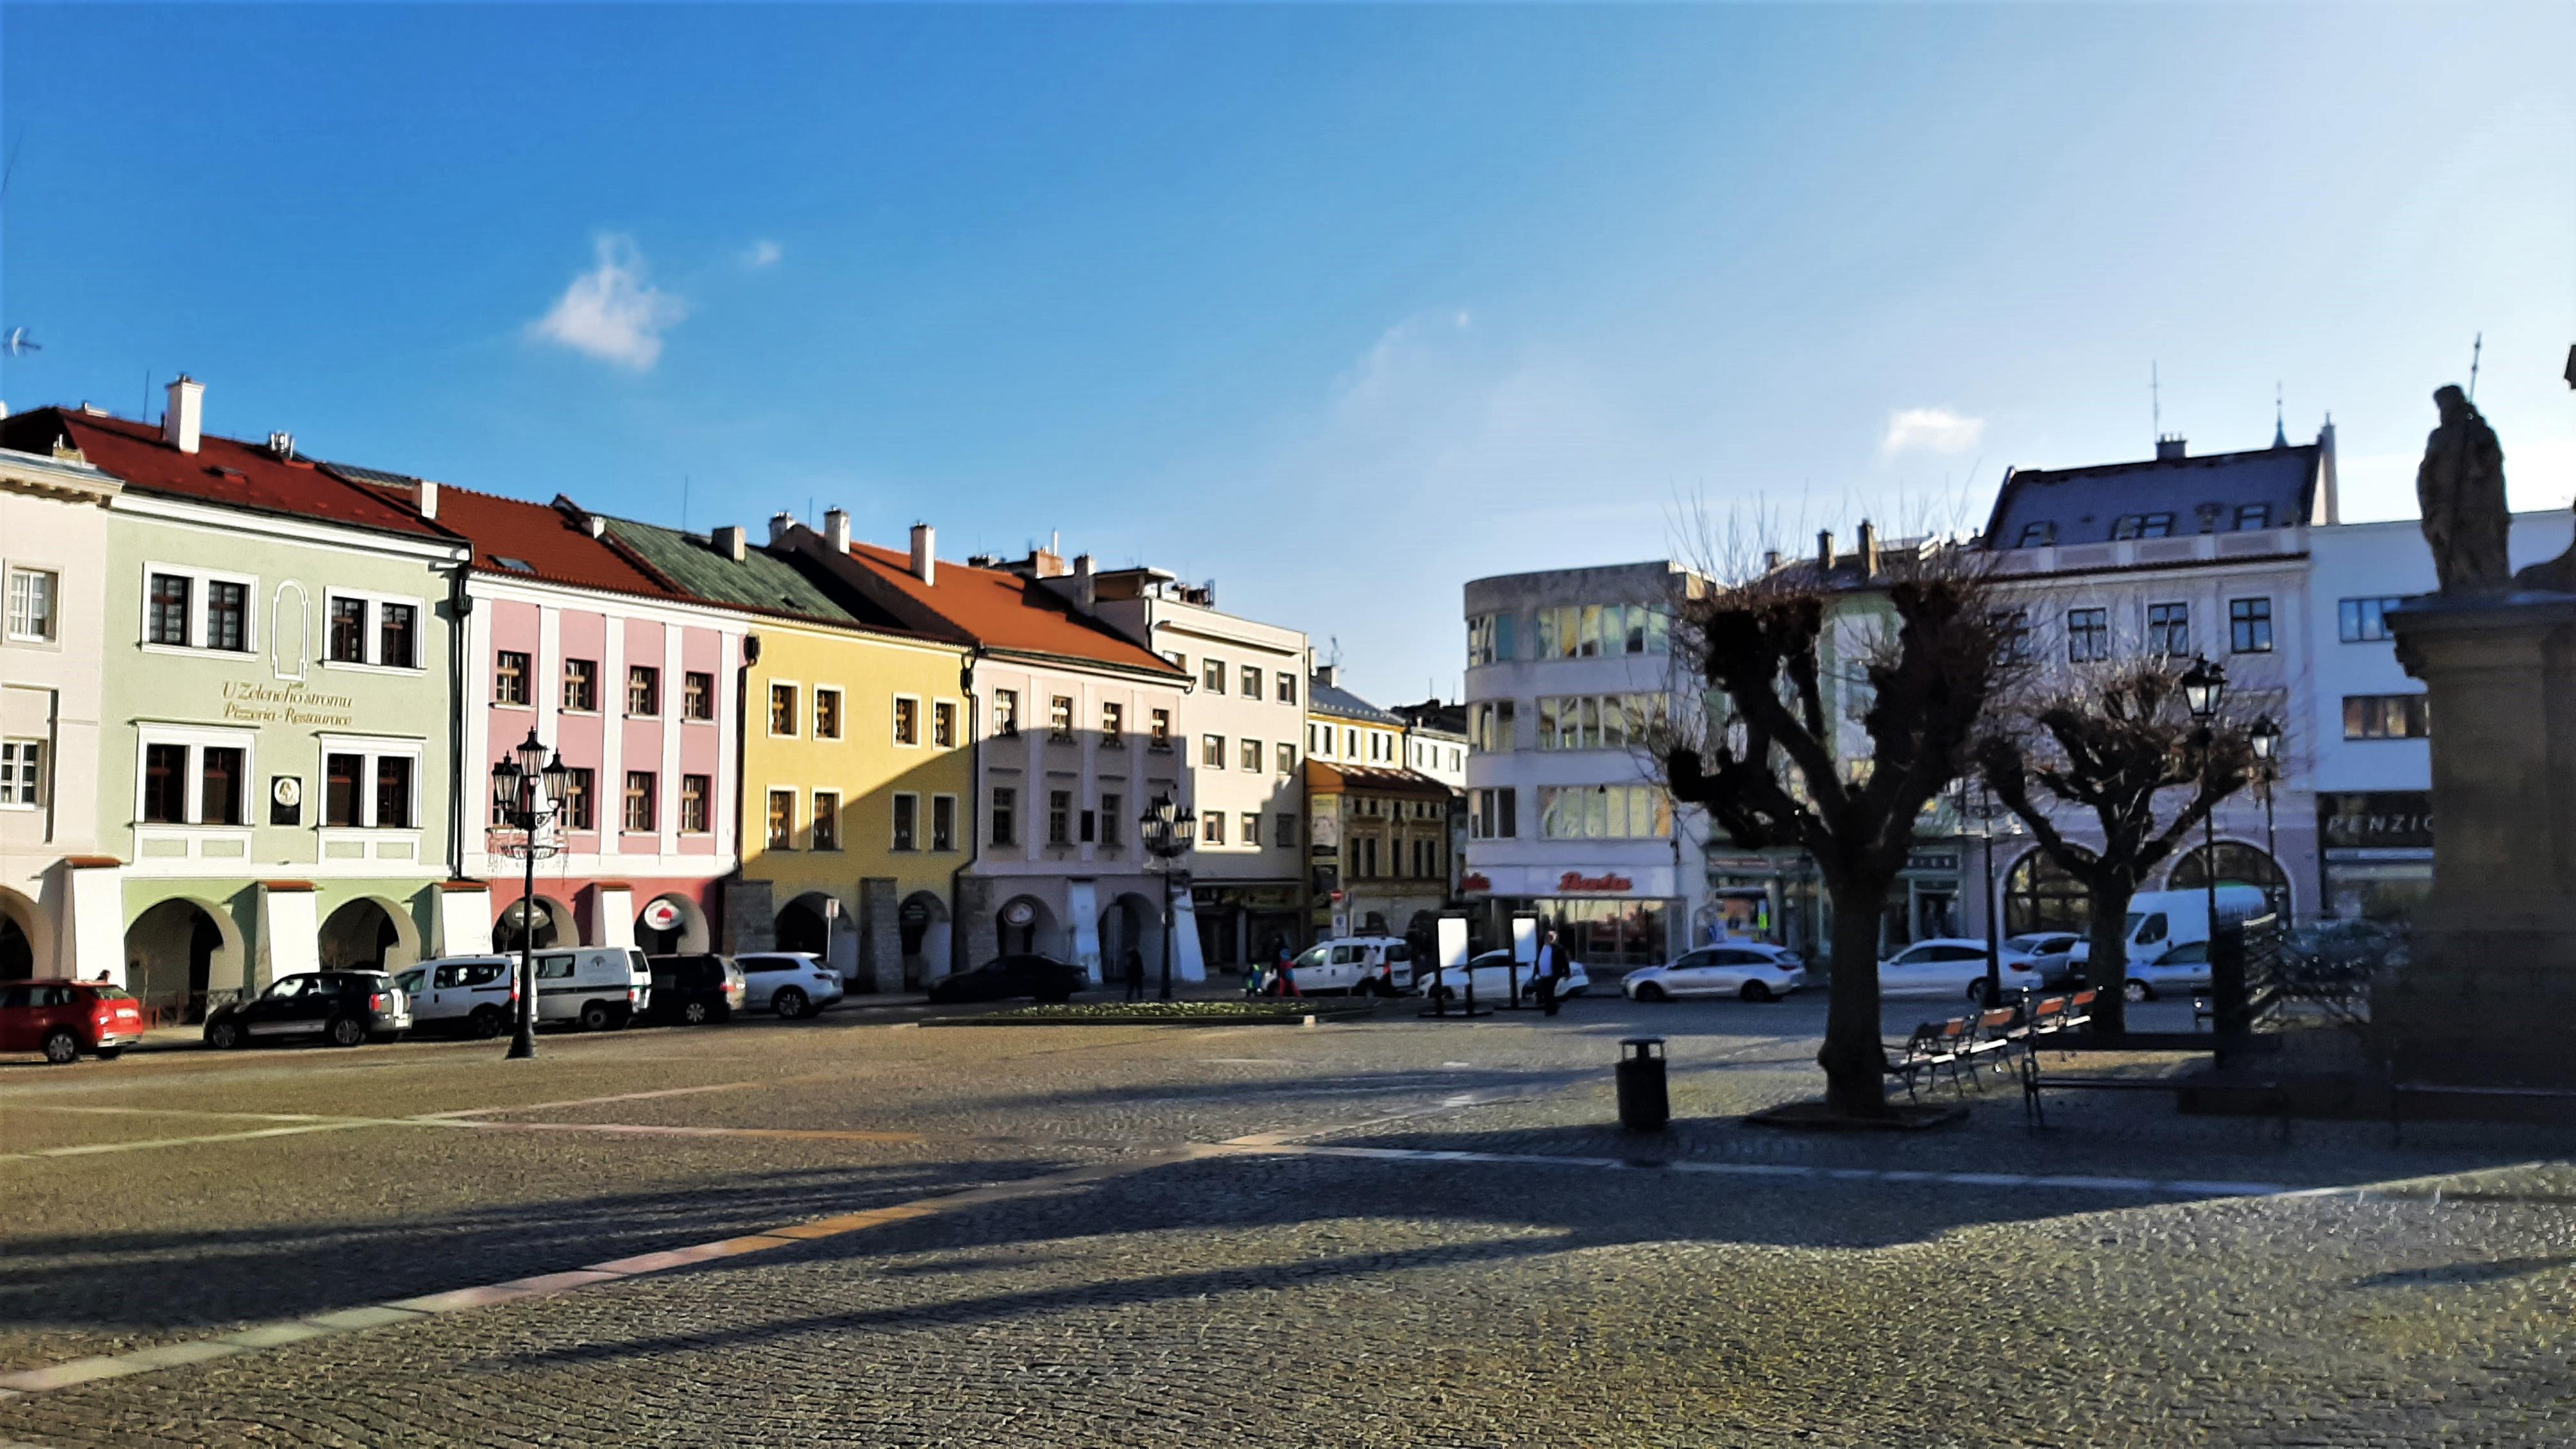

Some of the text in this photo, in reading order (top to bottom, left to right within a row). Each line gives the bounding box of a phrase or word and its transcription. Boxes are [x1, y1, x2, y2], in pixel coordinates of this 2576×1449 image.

[223, 681, 236, 698] U
[305, 693, 352, 708] stromu
[225, 702, 277, 721] Pizzeria
